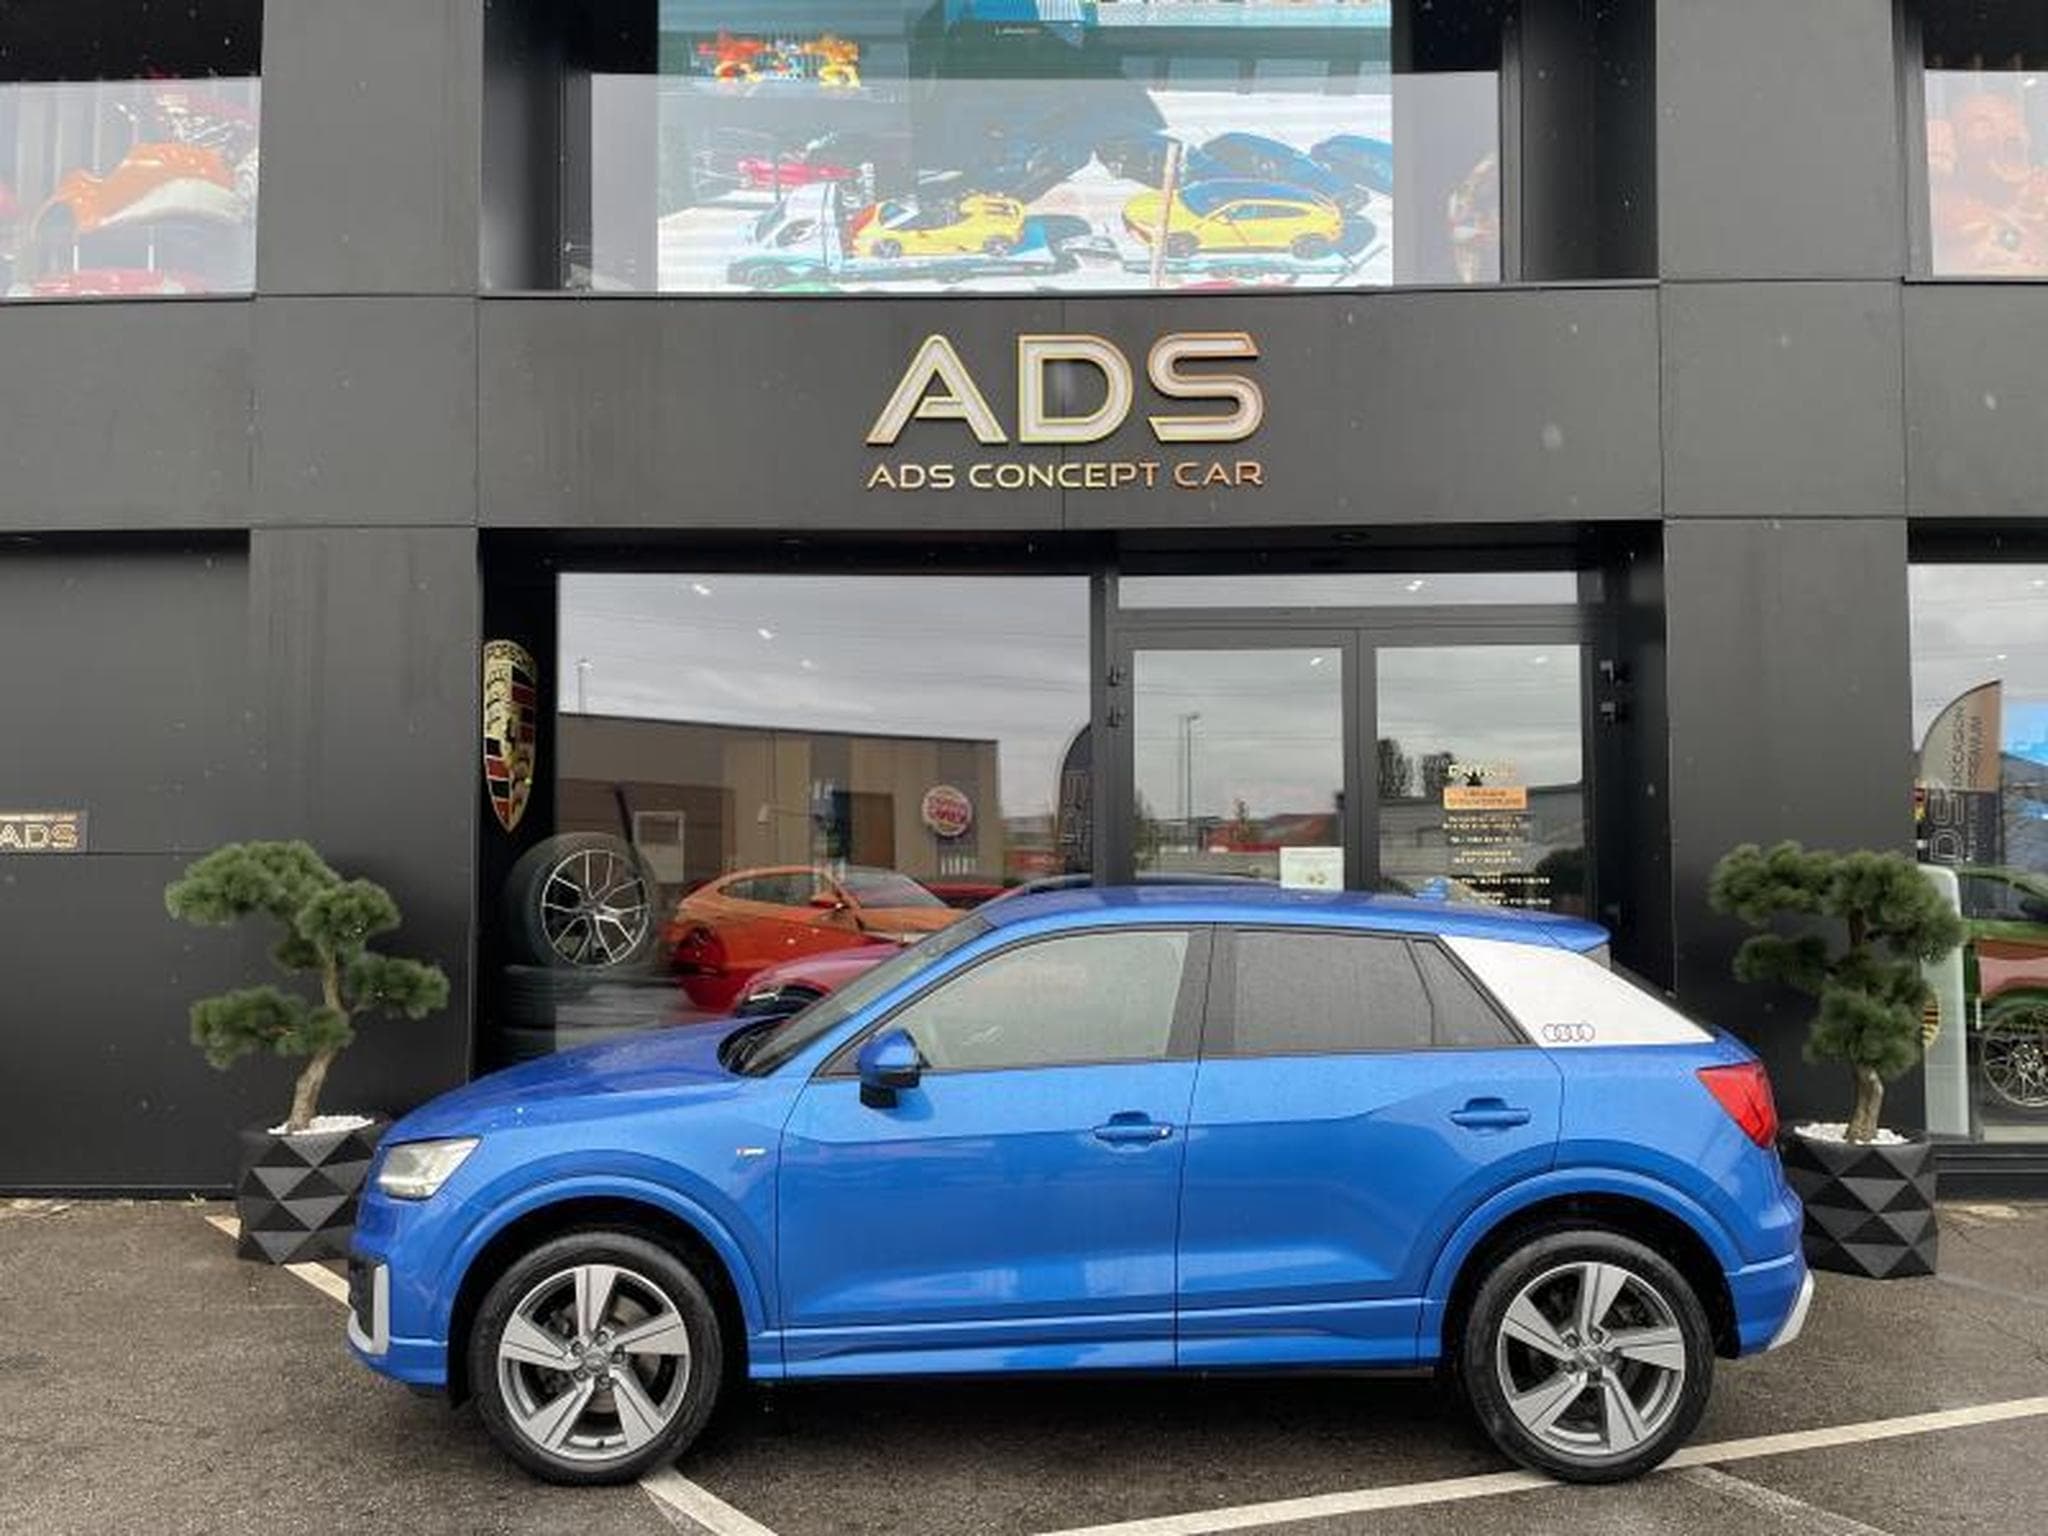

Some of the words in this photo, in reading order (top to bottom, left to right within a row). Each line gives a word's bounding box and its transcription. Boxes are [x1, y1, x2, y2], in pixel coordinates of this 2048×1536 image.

[866, 331, 1264, 445] ADS
[867, 463, 955, 489] ADS
[969, 463, 1160, 489] CONCEPT
[1173, 461, 1264, 487] CAR
[0, 823, 78, 849] ADS
